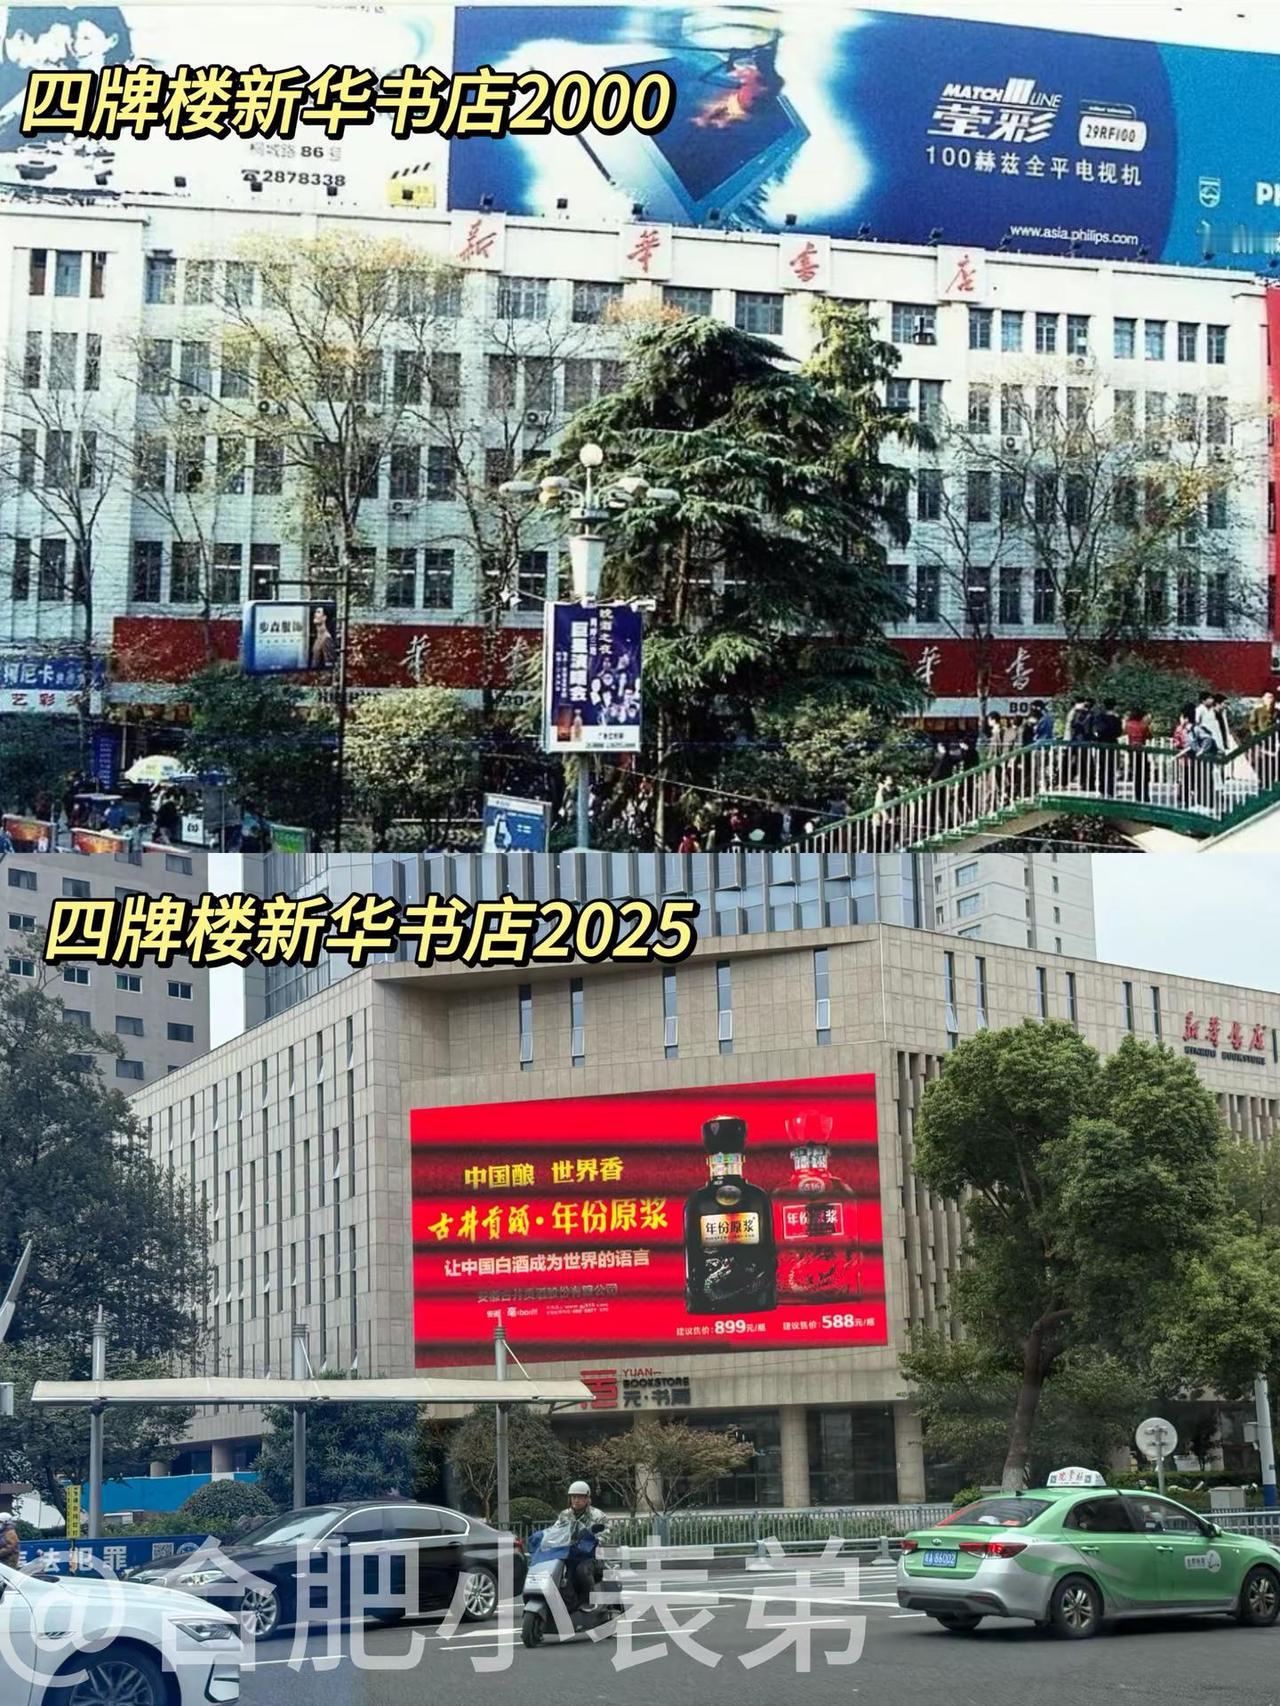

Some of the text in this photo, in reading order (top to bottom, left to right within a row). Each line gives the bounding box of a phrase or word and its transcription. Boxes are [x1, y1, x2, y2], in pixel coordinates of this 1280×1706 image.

[927, 103, 1057, 143] 莹彩
[1085, 124, 1136, 142] 29RF100
[925, 146, 1142, 186] 100赫兹全平电视机
[262, 170, 346, 187] 2878338
[1009, 225, 1139, 246] www.asia.philips.com
[464, 1156, 625, 1190] 中国酿 世界香
[705, 1218, 754, 1235] 年份原浆
[787, 1209, 838, 1226] 年份浆
[444, 1248, 650, 1277] 让中国白酒成为世界的语言
[622, 1376, 690, 1388] BOOKSTORE
